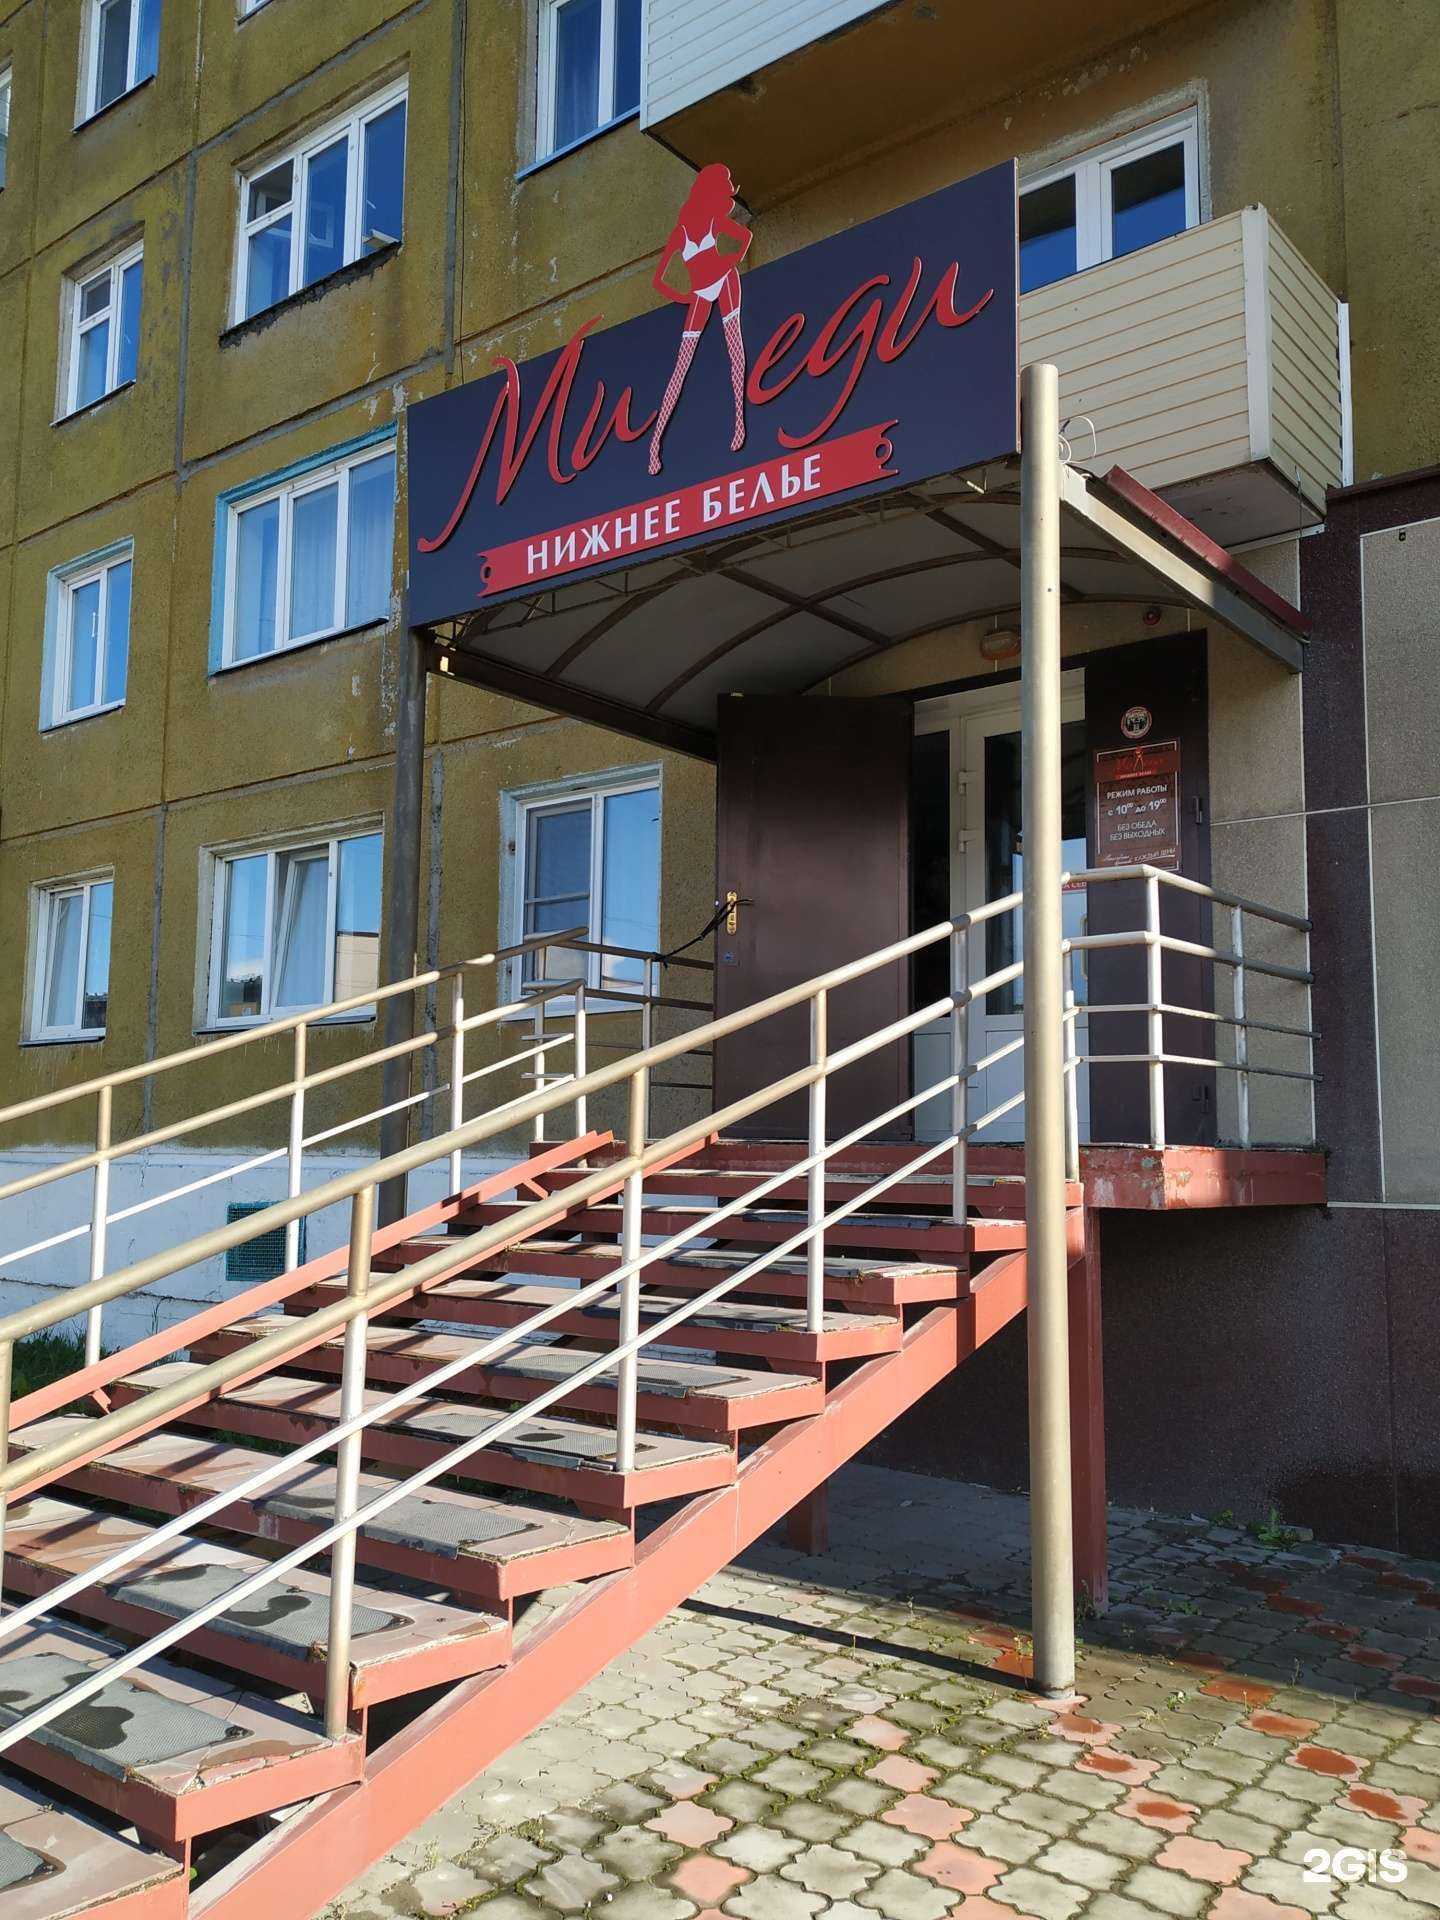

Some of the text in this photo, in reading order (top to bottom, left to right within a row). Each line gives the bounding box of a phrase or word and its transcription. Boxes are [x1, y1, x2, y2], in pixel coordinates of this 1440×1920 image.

[526, 453, 822, 575] НИЖНЕЕ БЕЛЬЕ
[1107, 784, 1168, 800] РЕЖИМ РАБОТЫ
[1117, 819, 1158, 831] БЕЗ ОБЕДА
[1110, 828, 1166, 841] БЕЗ ВЫХОДНЫХ
